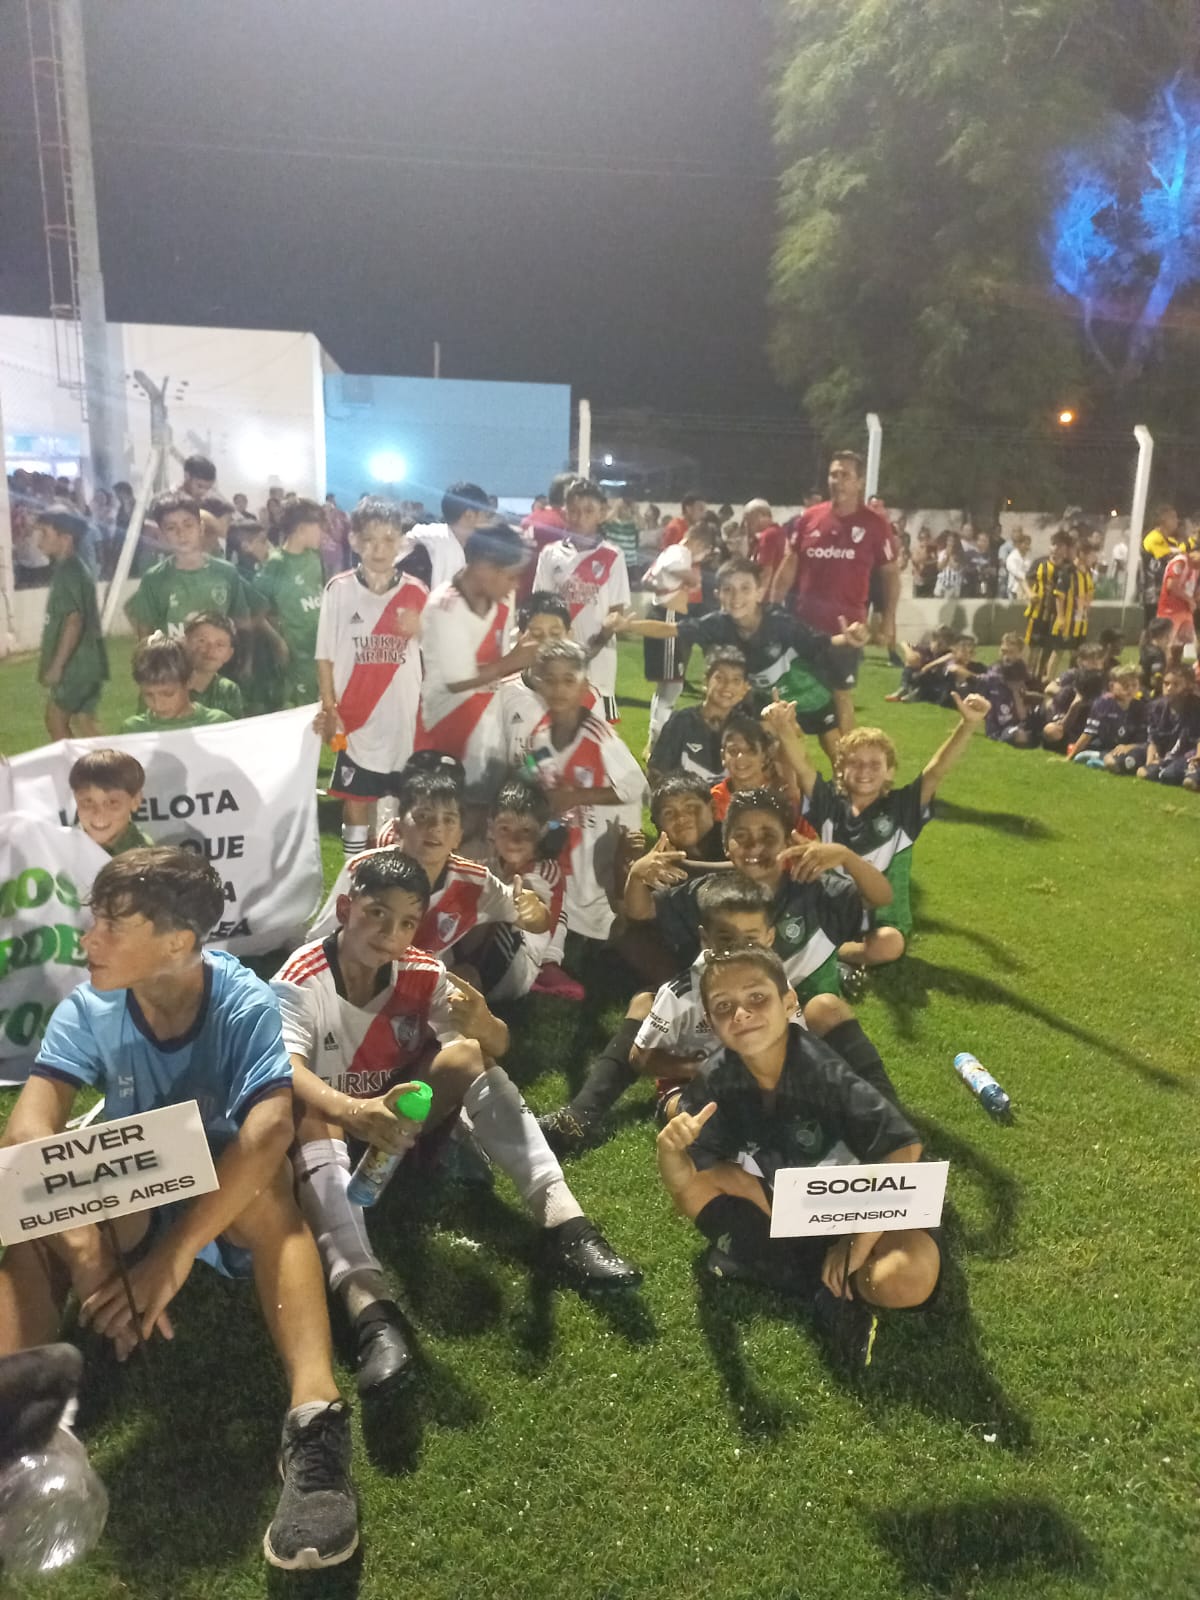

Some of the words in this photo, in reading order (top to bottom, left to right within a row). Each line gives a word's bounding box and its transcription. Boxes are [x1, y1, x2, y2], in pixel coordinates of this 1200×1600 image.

[806, 545, 856, 560] codere
[131, 788, 240, 823] ELOTA
[41, 1124, 145, 1165] RIVER
[43, 1150, 158, 1195] PLATE
[806, 1175, 917, 1196] SOCIAL
[19, 1195, 120, 1231] BUENOS
[129, 1175, 196, 1203] AIRES
[808, 1208, 908, 1224] ASCENSION
